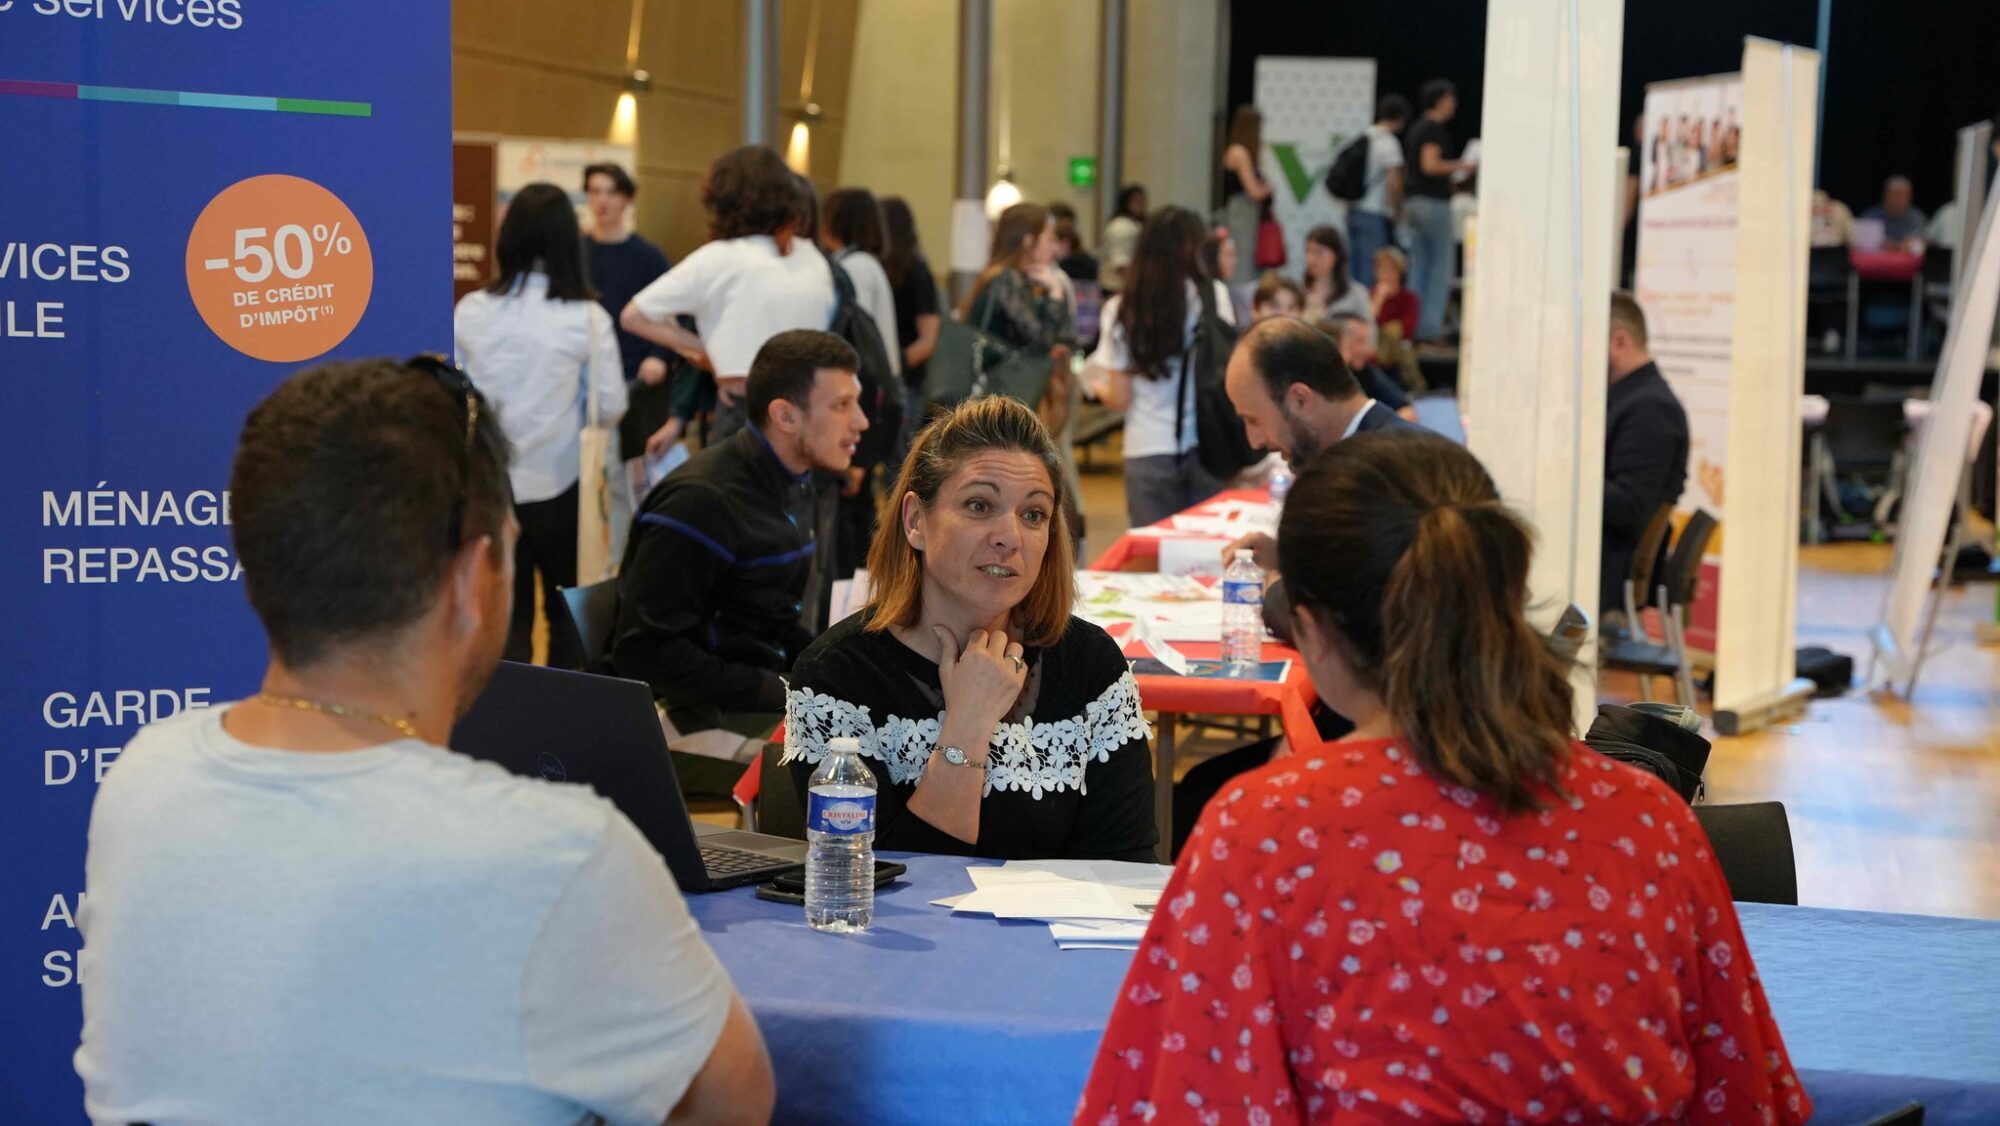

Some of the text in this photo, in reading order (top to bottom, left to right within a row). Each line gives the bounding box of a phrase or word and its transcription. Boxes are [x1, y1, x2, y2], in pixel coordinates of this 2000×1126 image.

[204, 221, 352, 283] -50%
[233, 283, 335, 307] DE CRÉDIT
[0, 300, 65, 338] LE
[41, 892, 87, 931] A
[42, 949, 86, 988] S
